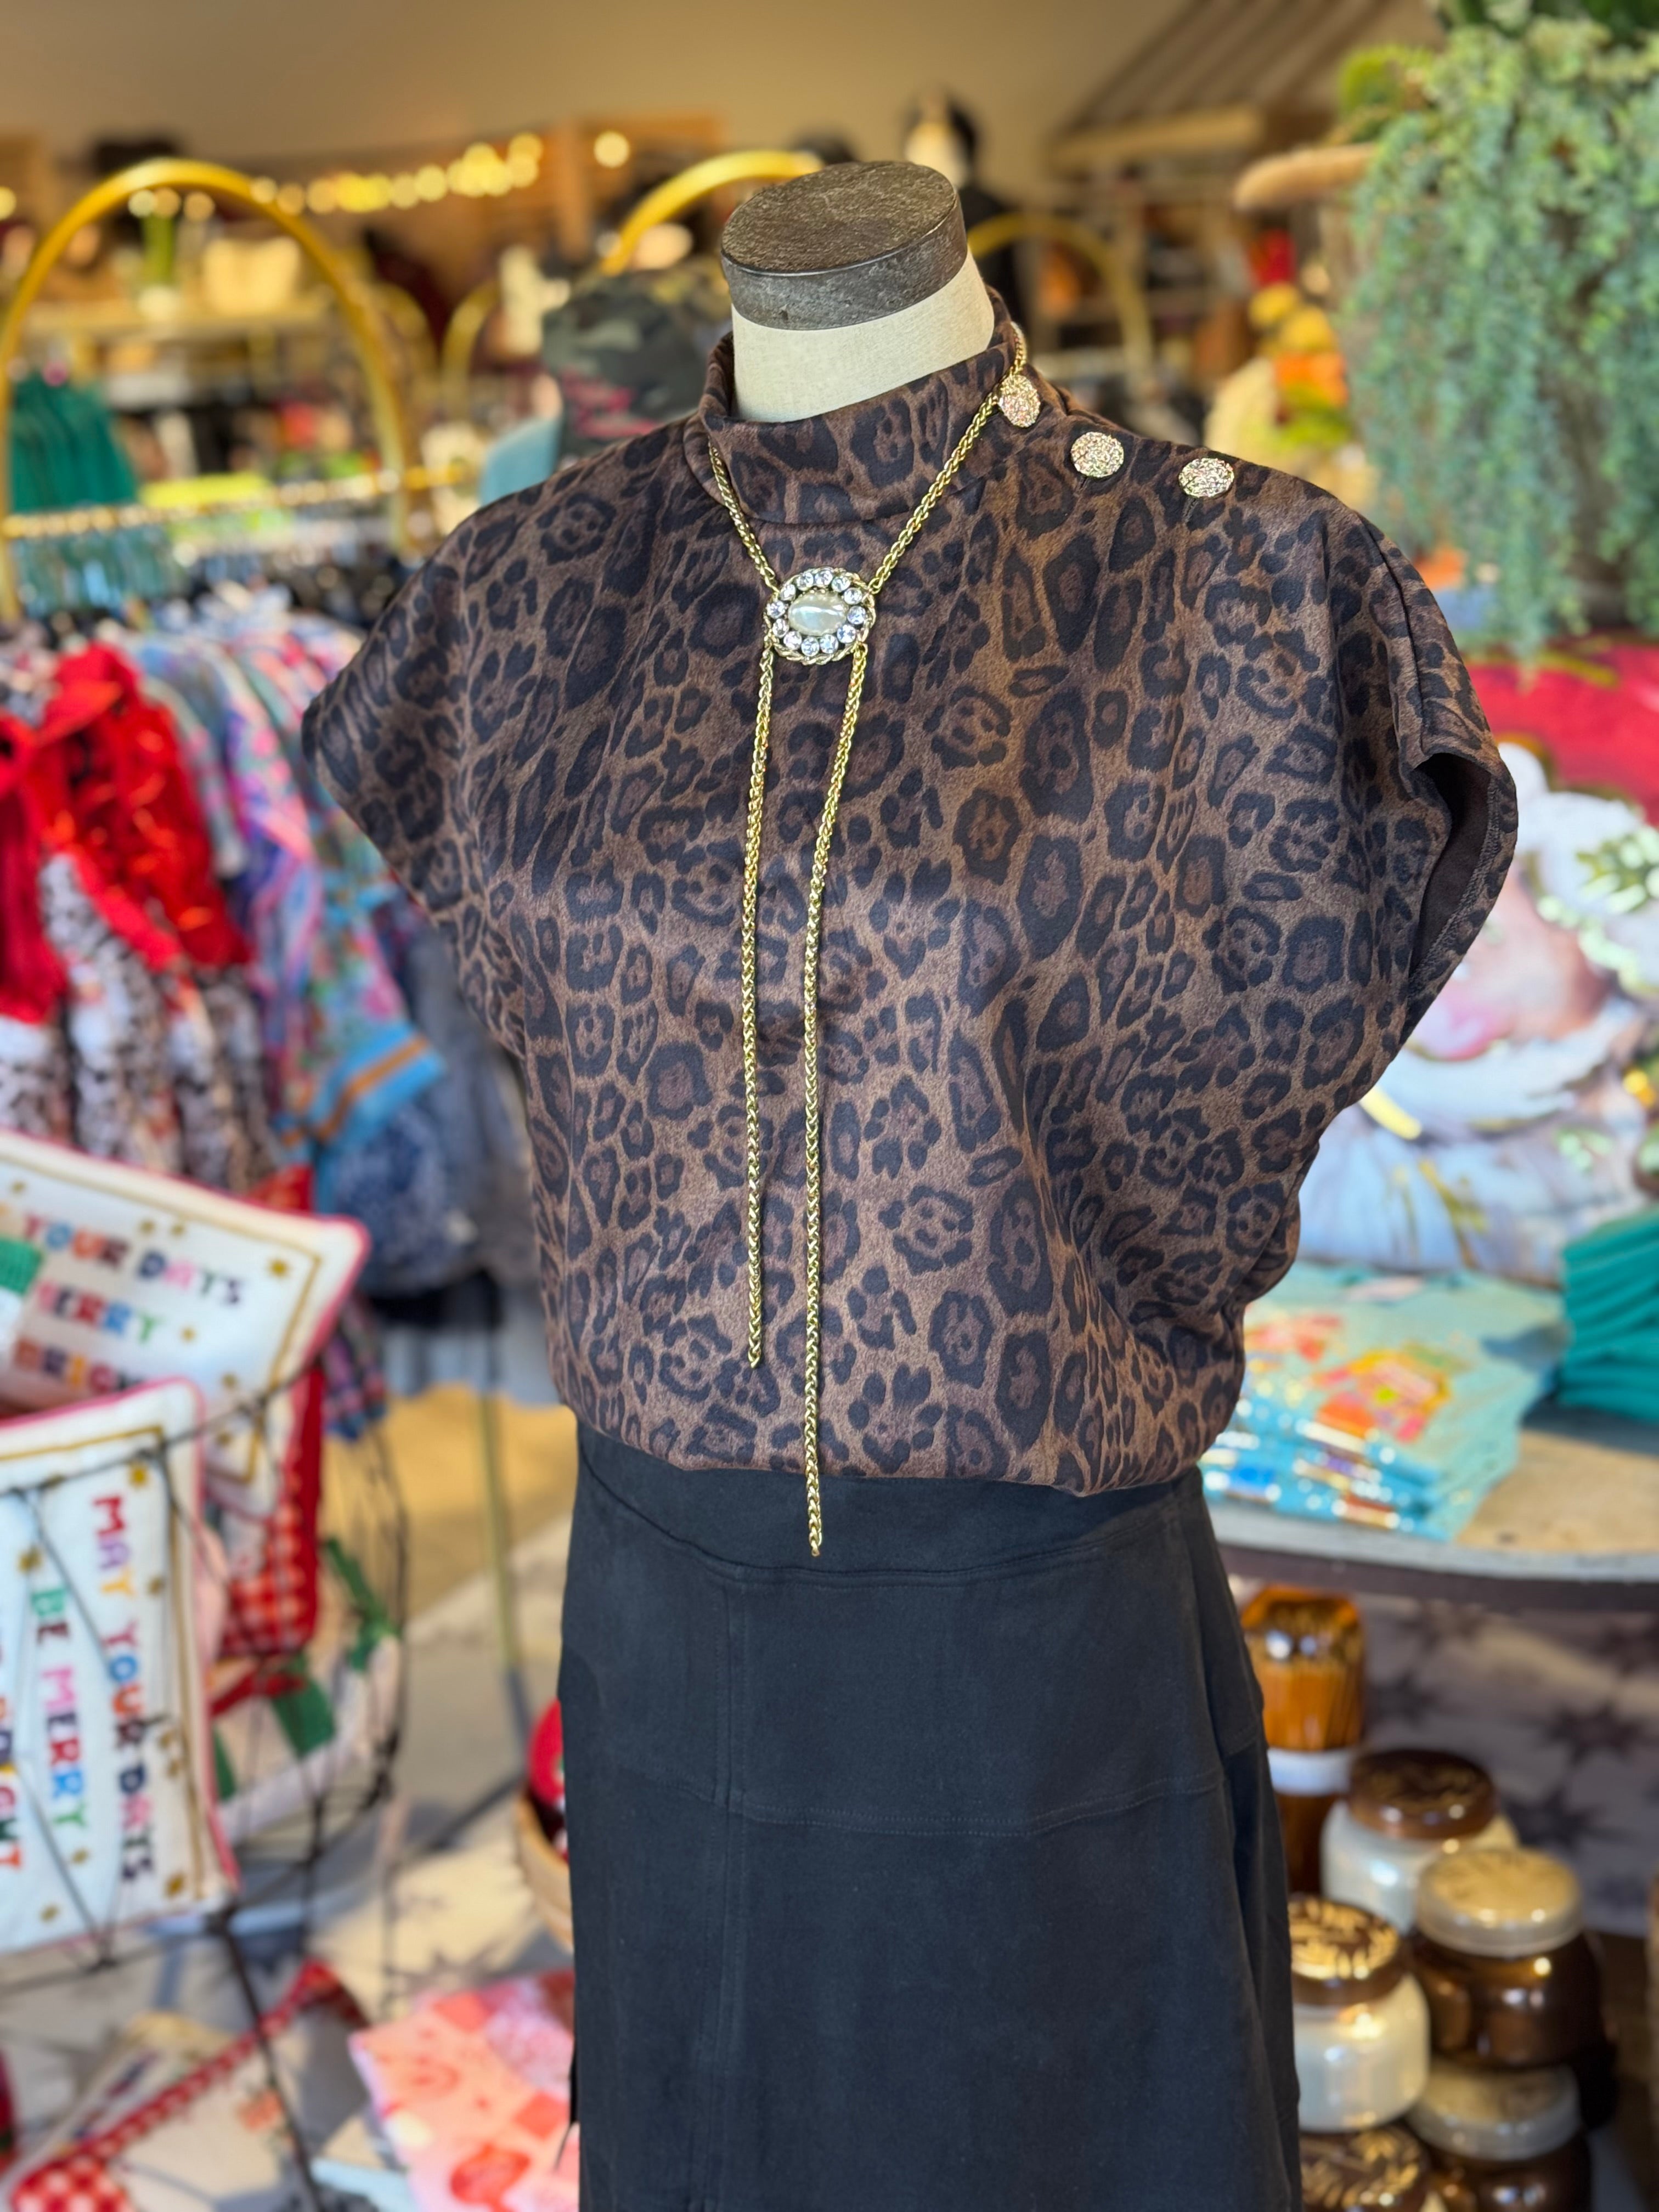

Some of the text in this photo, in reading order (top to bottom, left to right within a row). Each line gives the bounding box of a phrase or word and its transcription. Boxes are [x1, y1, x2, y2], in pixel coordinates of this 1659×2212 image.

[24, 1214, 245, 1306] YOUR DAYS
[30, 1588, 88, 1829] BE MERRY
[93, 1494, 155, 1883] MAY YOUR DAYS
